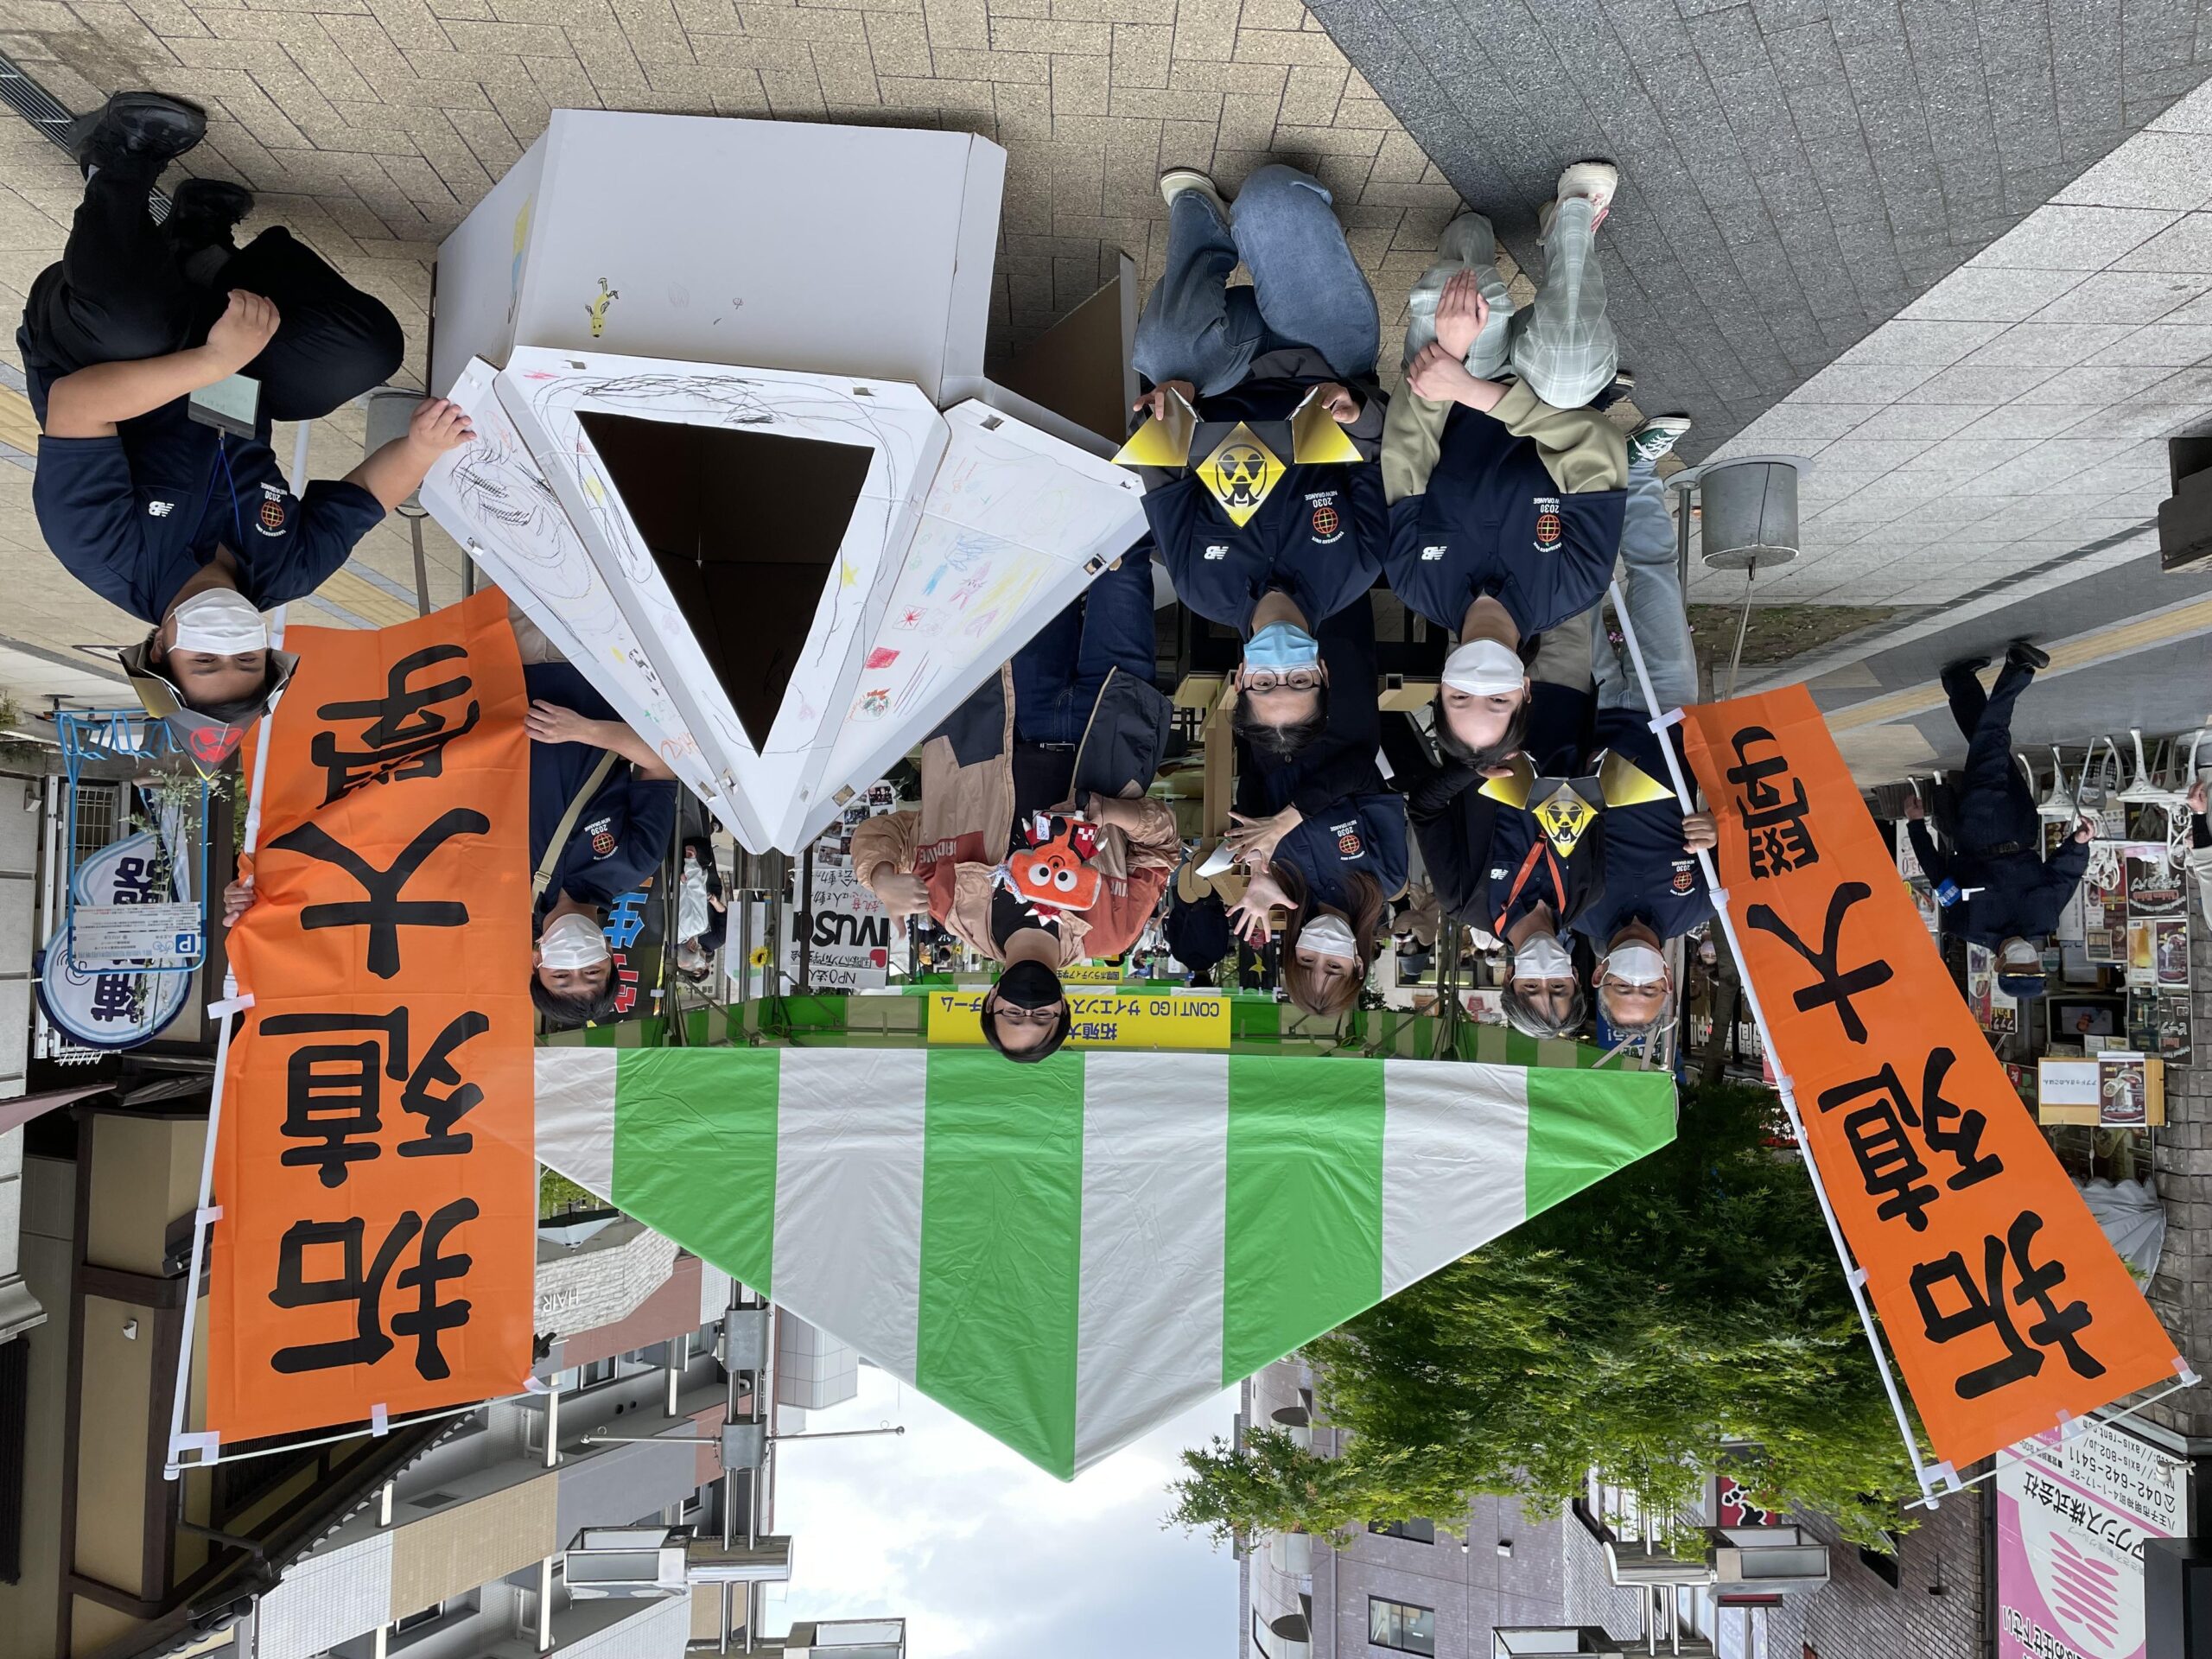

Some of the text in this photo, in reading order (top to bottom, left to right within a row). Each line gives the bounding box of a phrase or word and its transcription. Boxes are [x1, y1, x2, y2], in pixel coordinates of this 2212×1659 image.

[264, 490, 281, 503] 2030
[1312, 497, 1333, 508] 2030
[1540, 504, 1560, 513] 2030
[590, 824, 608, 836] 2030
[1337, 826, 1353, 837] 2030
[179, 936, 192, 951] P
[791, 950, 871, 969] 国際ボランティア学生会
[941, 996, 981, 1013] チーム
[543, 1289, 579, 1313] HAIR
[2069, 1446, 2162, 1505] 042-642-5411
